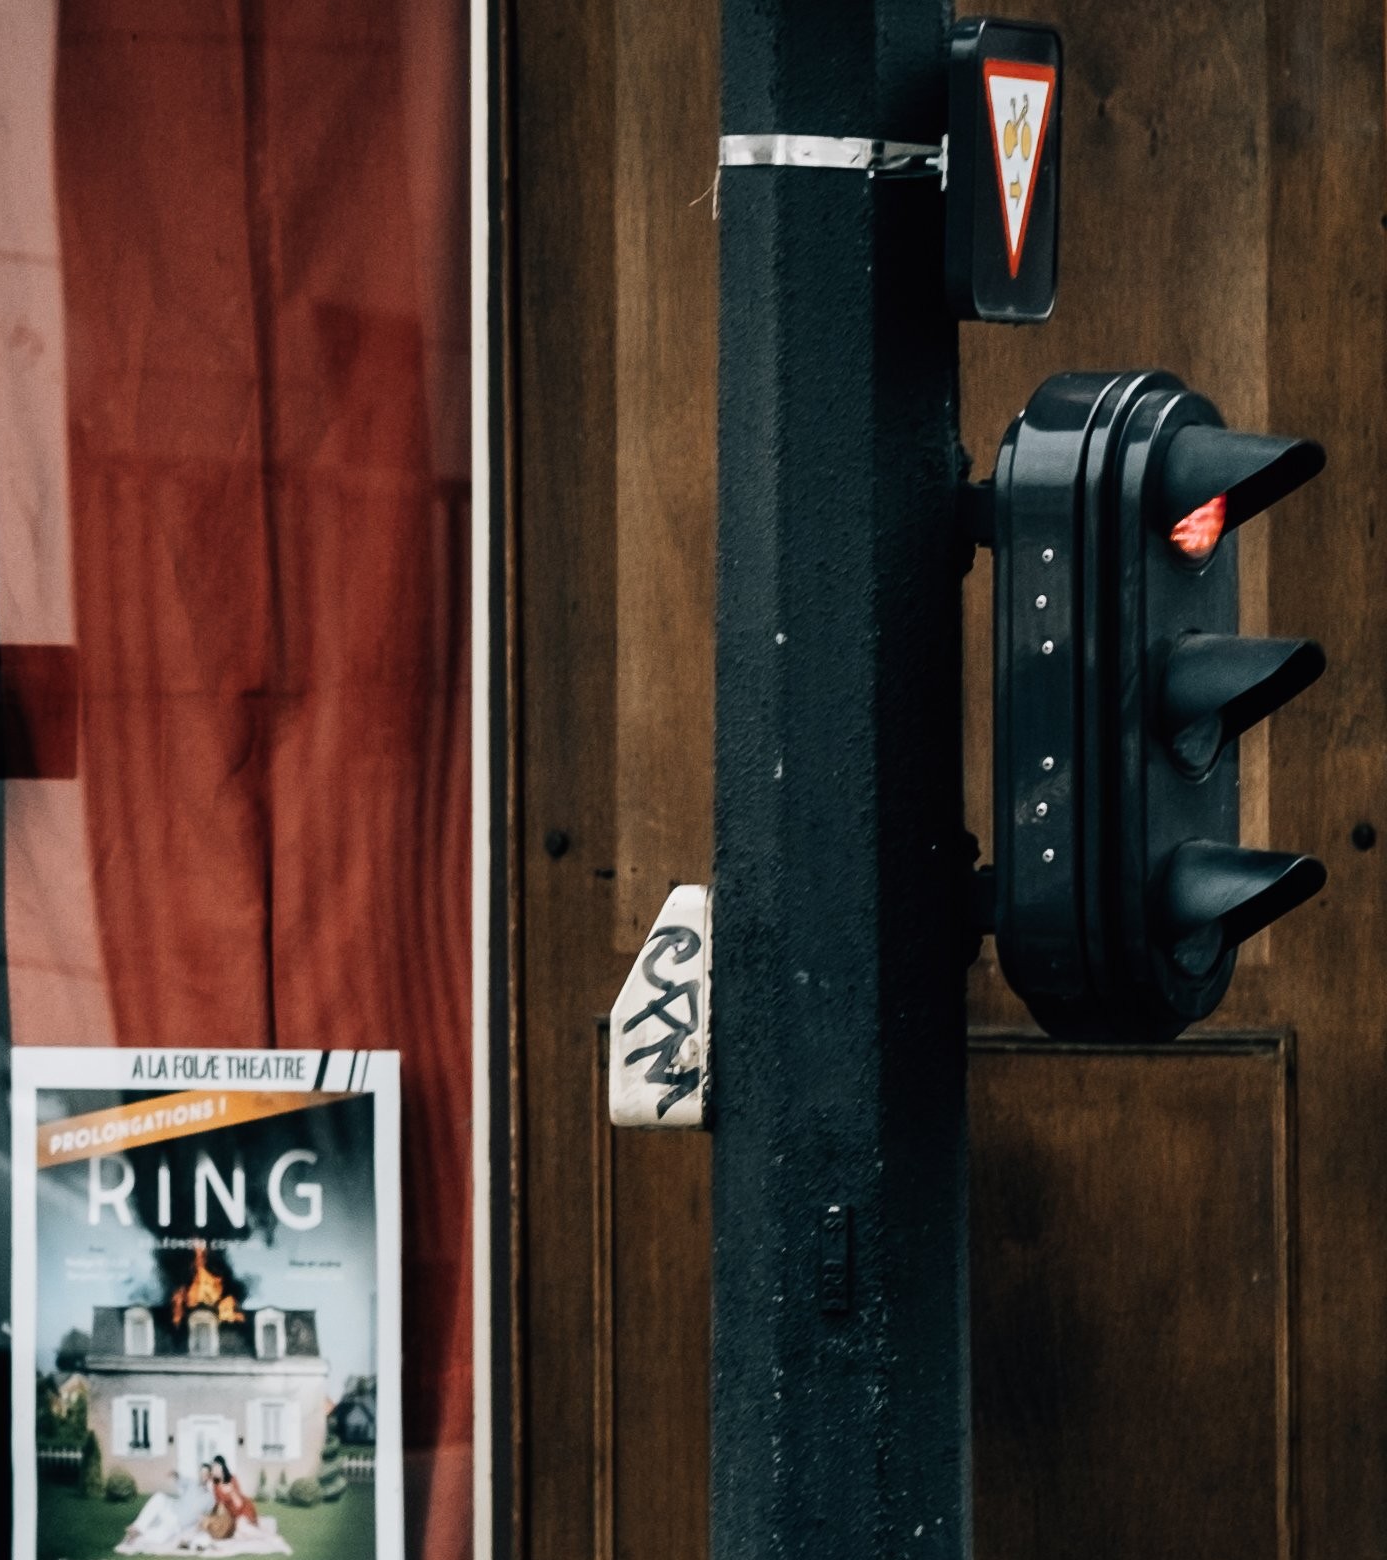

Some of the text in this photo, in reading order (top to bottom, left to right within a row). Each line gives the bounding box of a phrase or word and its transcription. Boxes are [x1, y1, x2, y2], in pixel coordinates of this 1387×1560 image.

[132, 1055, 144, 1079] A
[147, 1055, 169, 1079] LA
[225, 1056, 307, 1081] THEATRE
[49, 1098, 215, 1155] PROLONGATIONS
[87, 1148, 324, 1230] RING
